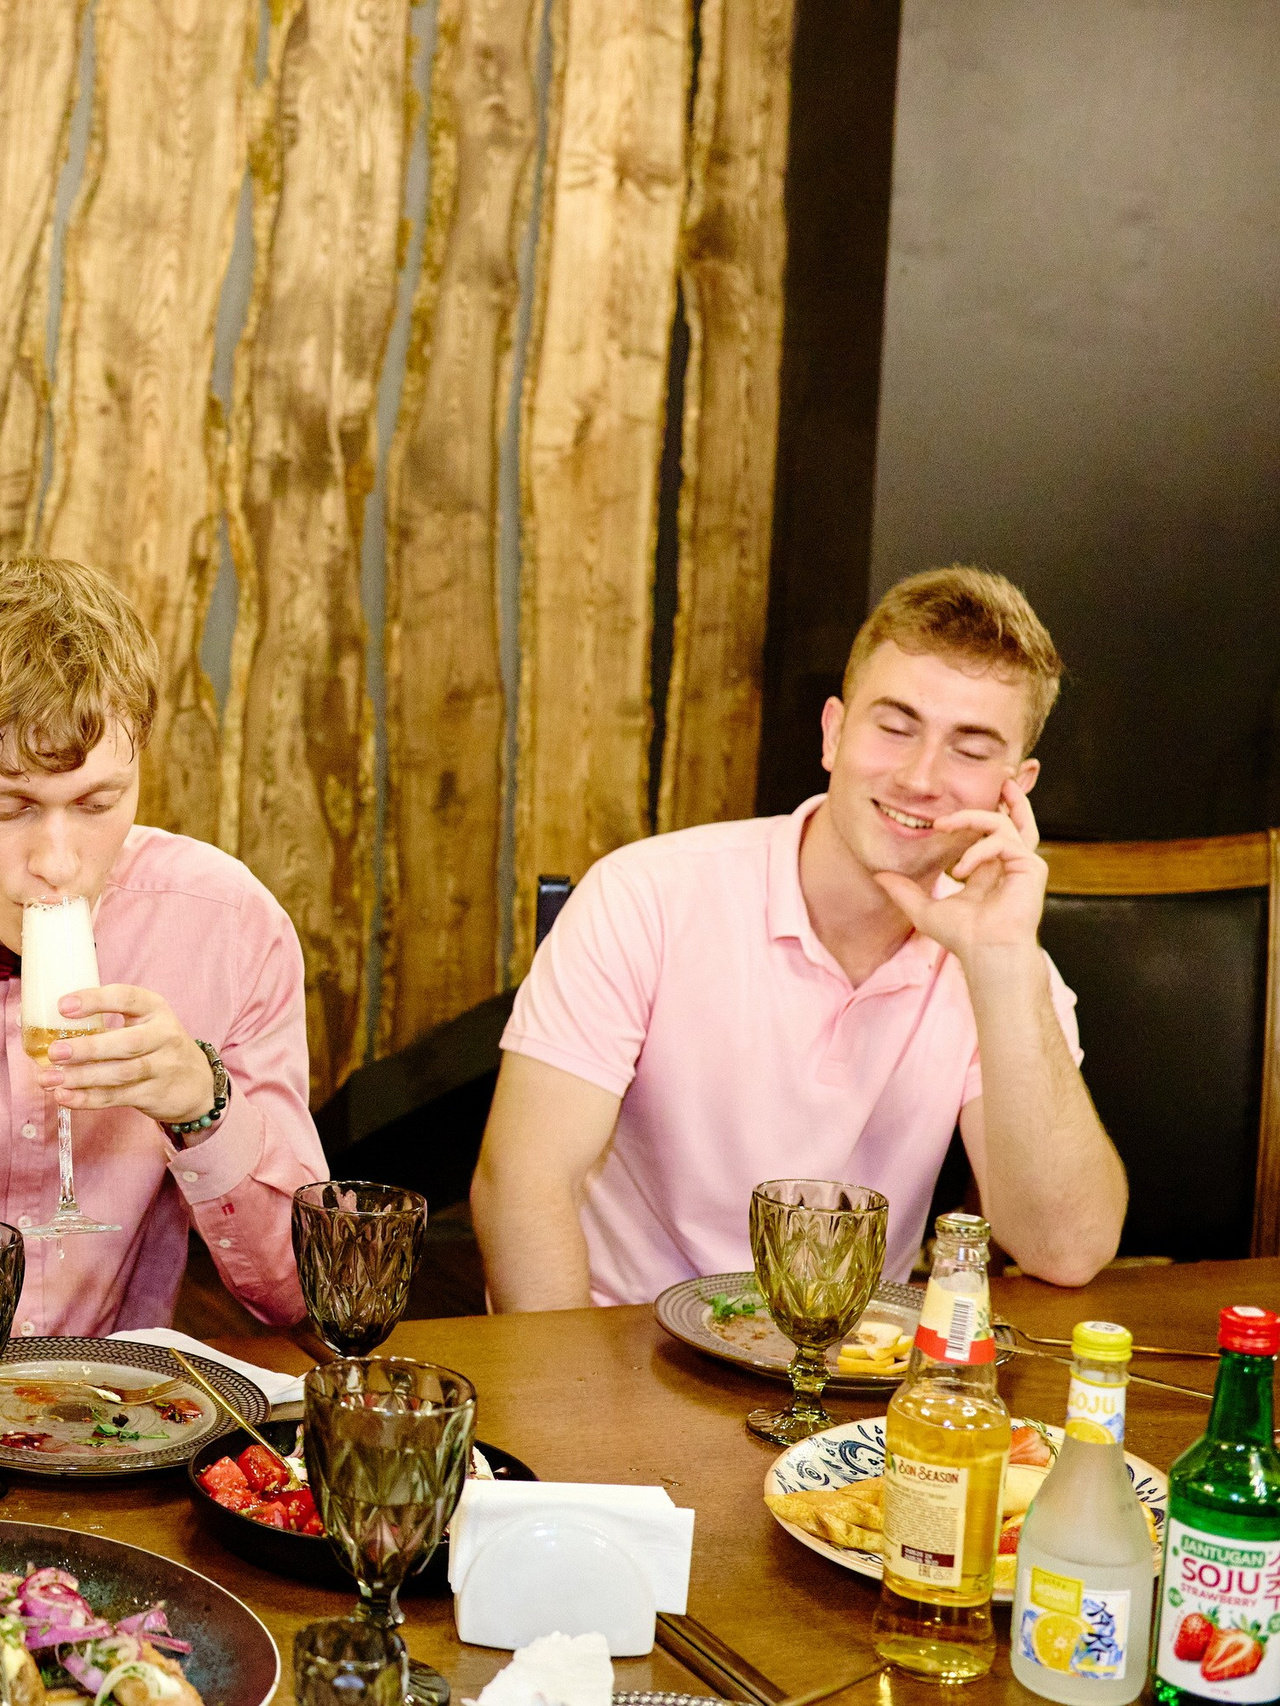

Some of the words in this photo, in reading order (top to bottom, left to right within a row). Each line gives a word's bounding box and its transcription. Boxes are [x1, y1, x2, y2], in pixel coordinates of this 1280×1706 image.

[1183, 1537, 1264, 1567] JANTUGAN
[1181, 1557, 1260, 1595] SOJU
[1181, 1582, 1258, 1607] STRAWBERRY
